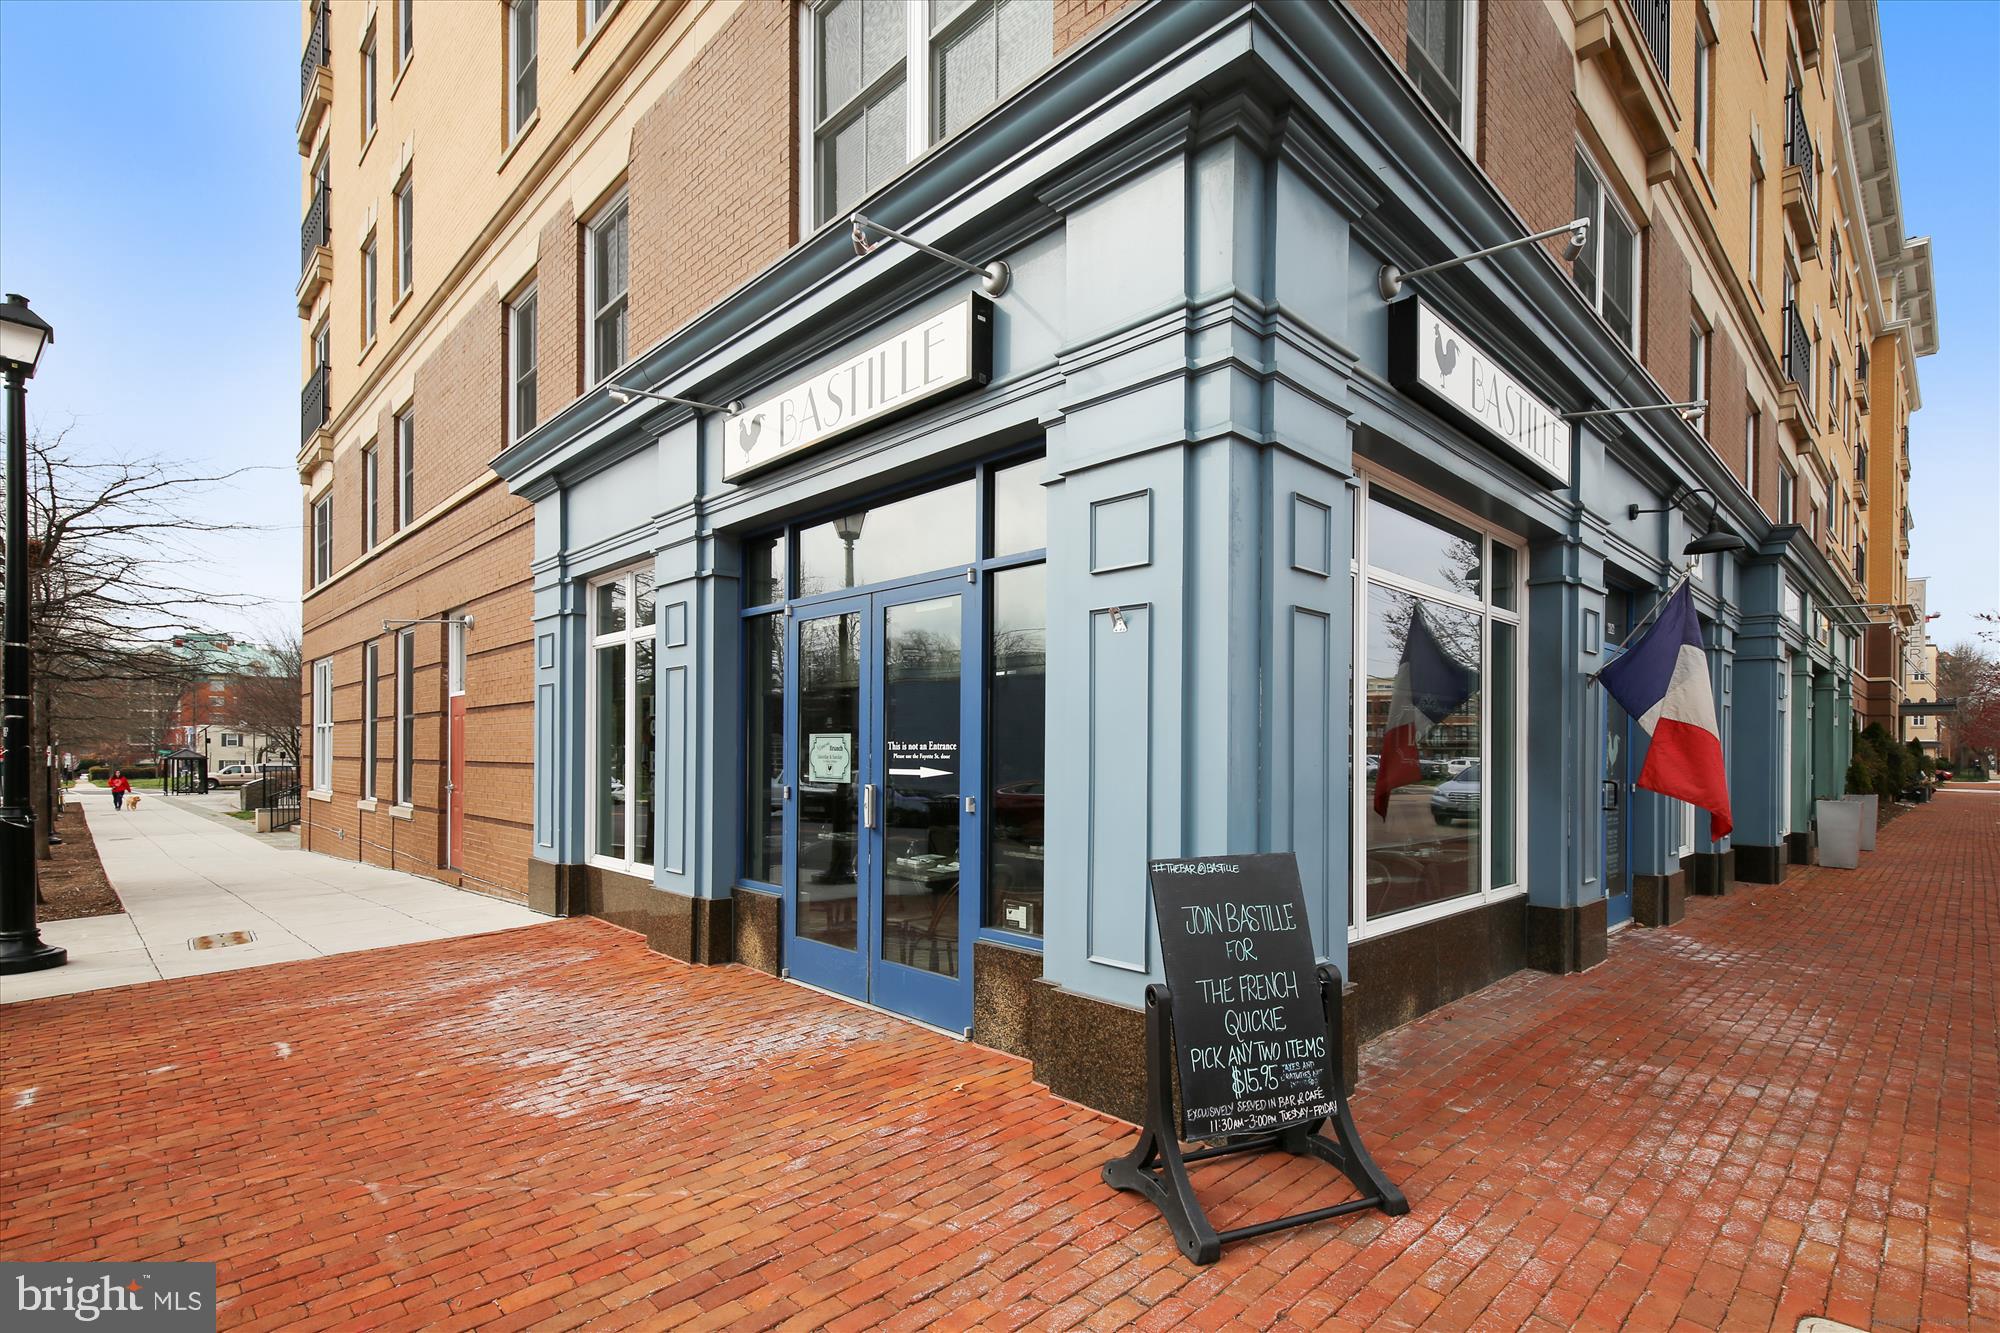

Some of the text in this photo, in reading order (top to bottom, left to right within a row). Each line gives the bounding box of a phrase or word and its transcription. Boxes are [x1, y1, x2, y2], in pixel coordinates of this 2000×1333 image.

[780, 321, 945, 448] BASTILLE
[1472, 355, 1564, 471] BASTILLE
[887, 740, 957, 751] This is not an Entrance
[1181, 902, 1296, 935] JOIN BASTILLE
[1225, 938, 1258, 961] FOR
[1195, 971, 1299, 1004] THE FRENCH
[1224, 1006, 1287, 1042] QUICKIE
[1190, 1037, 1326, 1072] PICK ANY TWO ITEMS
[1231, 1064, 1279, 1099] $15.95
[1237, 1099, 1267, 1113] SERVED
[1268, 1097, 1277, 1109] IN
[1278, 1094, 1296, 1109] BAR
[1297, 1092, 1305, 1106] &
